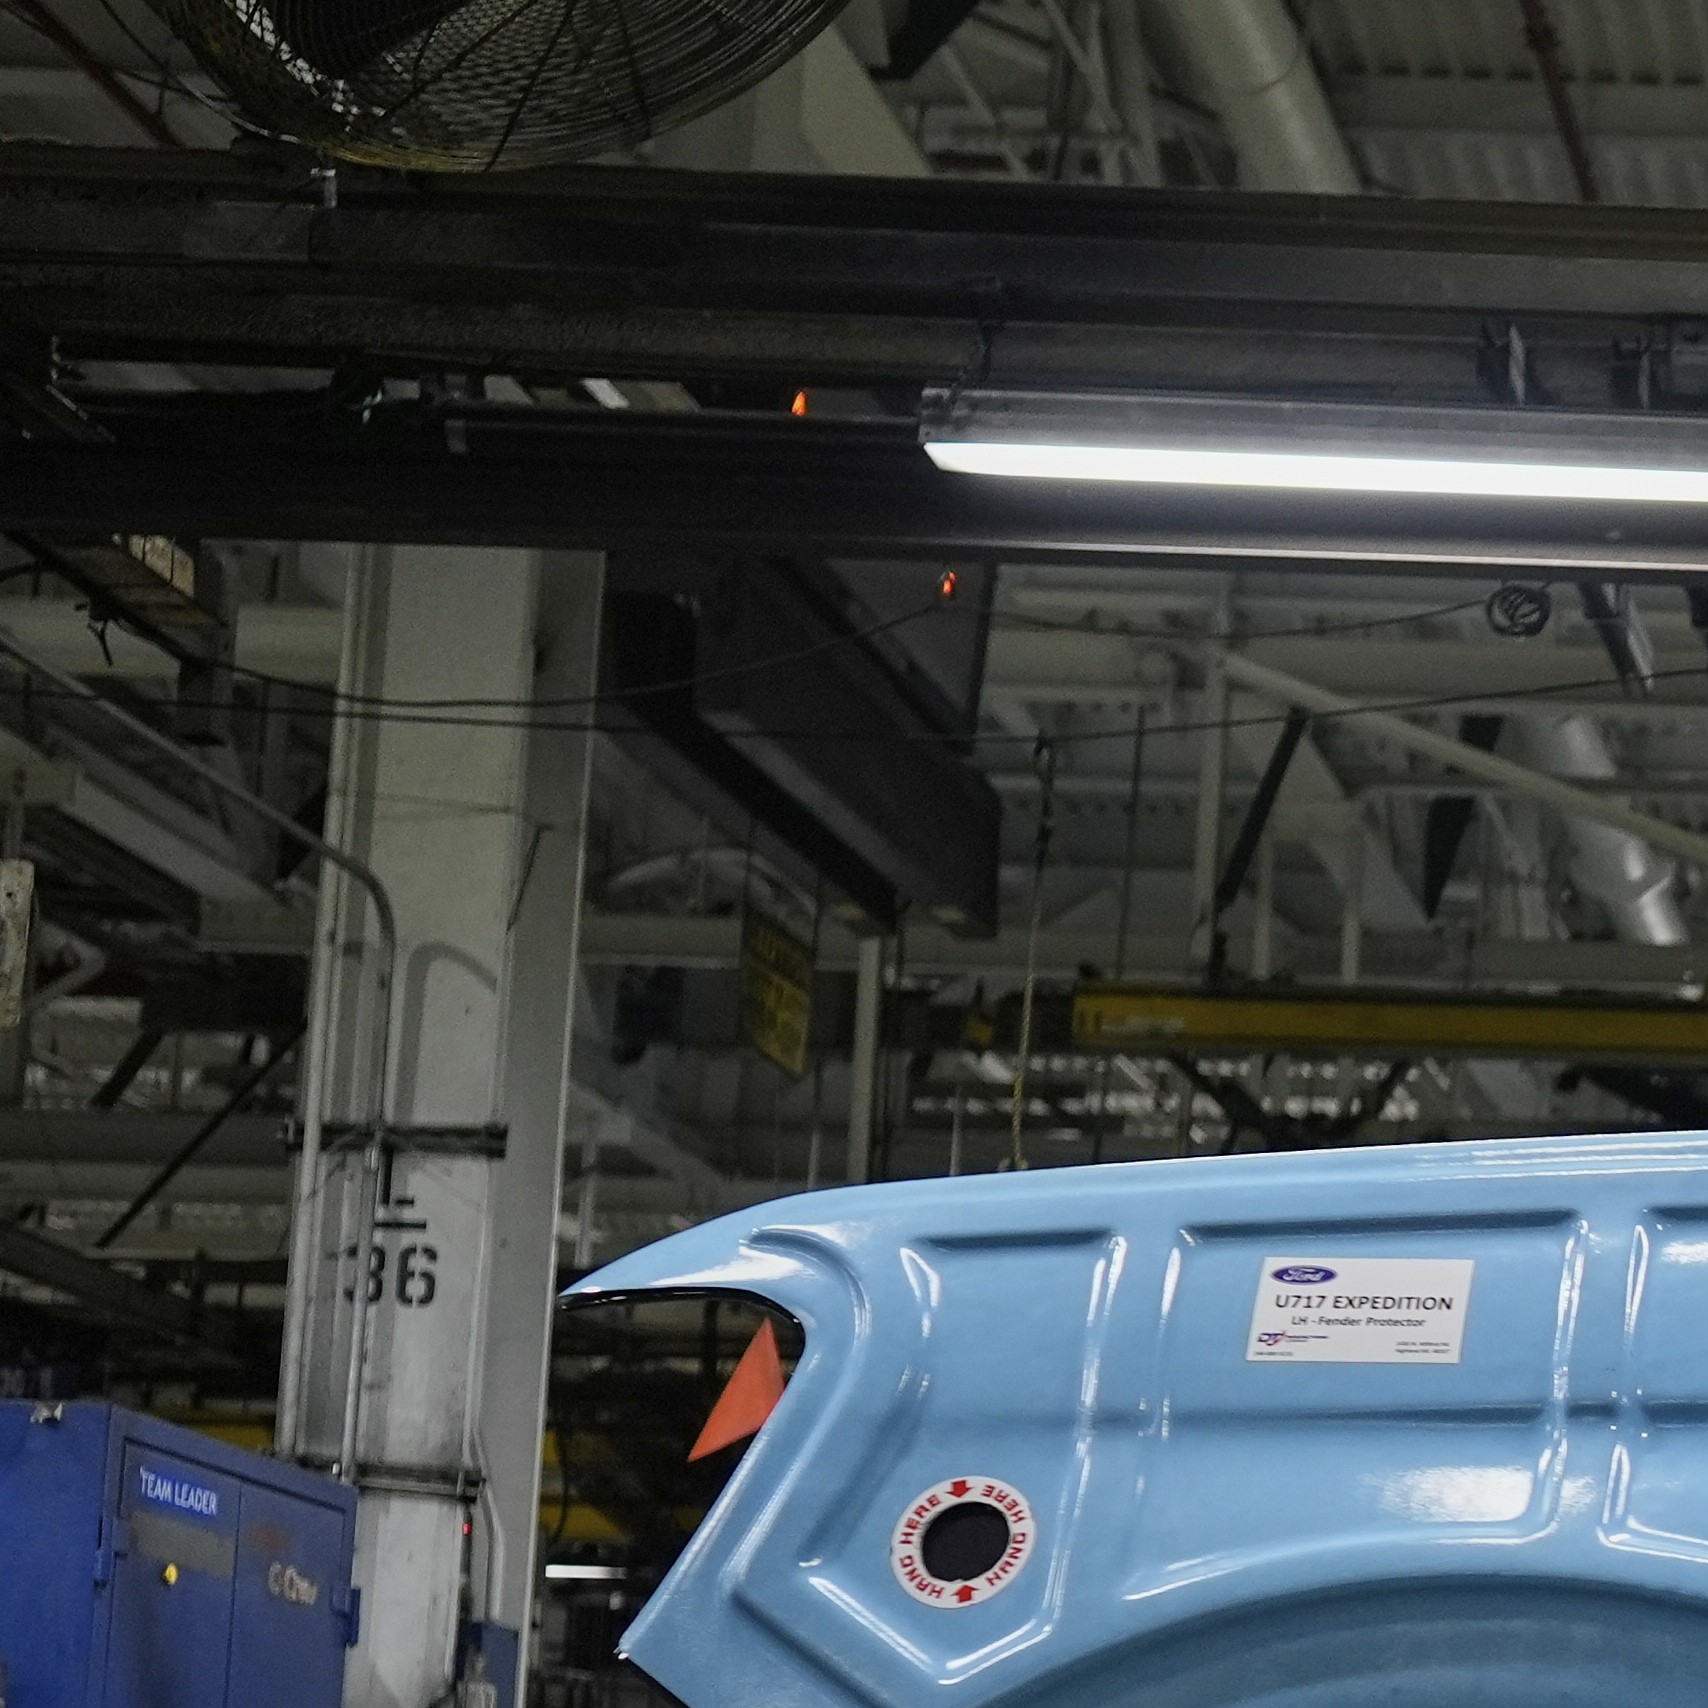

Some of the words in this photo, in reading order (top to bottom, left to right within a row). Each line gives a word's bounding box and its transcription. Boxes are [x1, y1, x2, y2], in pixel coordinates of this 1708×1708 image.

[343, 1243, 437, 1306] 36
[1275, 1294, 1326, 1309] U717
[1332, 1295, 1454, 1311] EXPEDITION
[1291, 1315, 1308, 1326] LH
[1318, 1315, 1362, 1327] Fender
[1365, 1316, 1426, 1328] Protector
[139, 1465, 172, 1502] TEAM
[174, 1480, 218, 1516] LEADER
[981, 1484, 1027, 1524] HERE
[899, 1494, 943, 1545] HERE
[899, 1554, 946, 1599] HAND
[986, 1532, 1027, 1586] HAND
